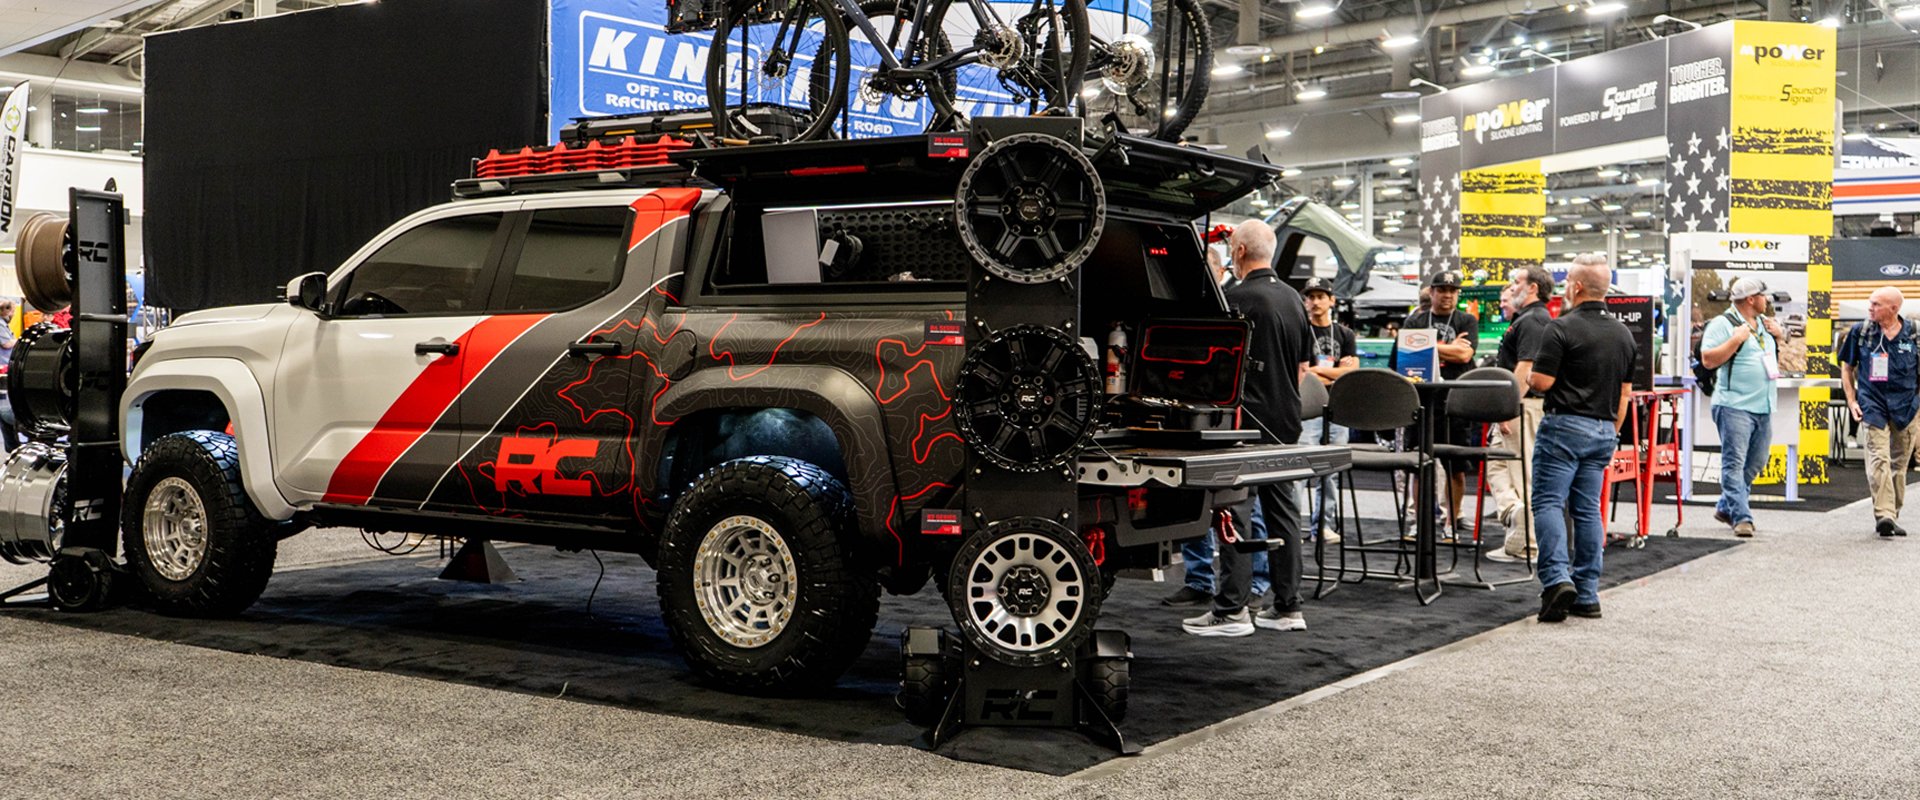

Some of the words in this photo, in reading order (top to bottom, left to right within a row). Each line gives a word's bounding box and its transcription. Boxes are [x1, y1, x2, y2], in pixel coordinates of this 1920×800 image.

[589, 27, 755, 91] KING
[1670, 57, 1726, 85] TOUGHER.
[626, 82, 660, 98] OFF
[673, 90, 709, 106] ROA
[1670, 76, 1729, 104] BRIGHTER.
[854, 120, 894, 134] ROAD
[1560, 112, 1590, 127] POWERED
[1591, 110, 1599, 122] BY
[1490, 127, 1516, 141] SILICONE
[1516, 122, 1544, 136] LIGHTING
[79, 241, 109, 263] RC
[494, 436, 599, 496] RC
[1247, 456, 1304, 471] TACOMA
[980, 689, 1058, 720] RC
